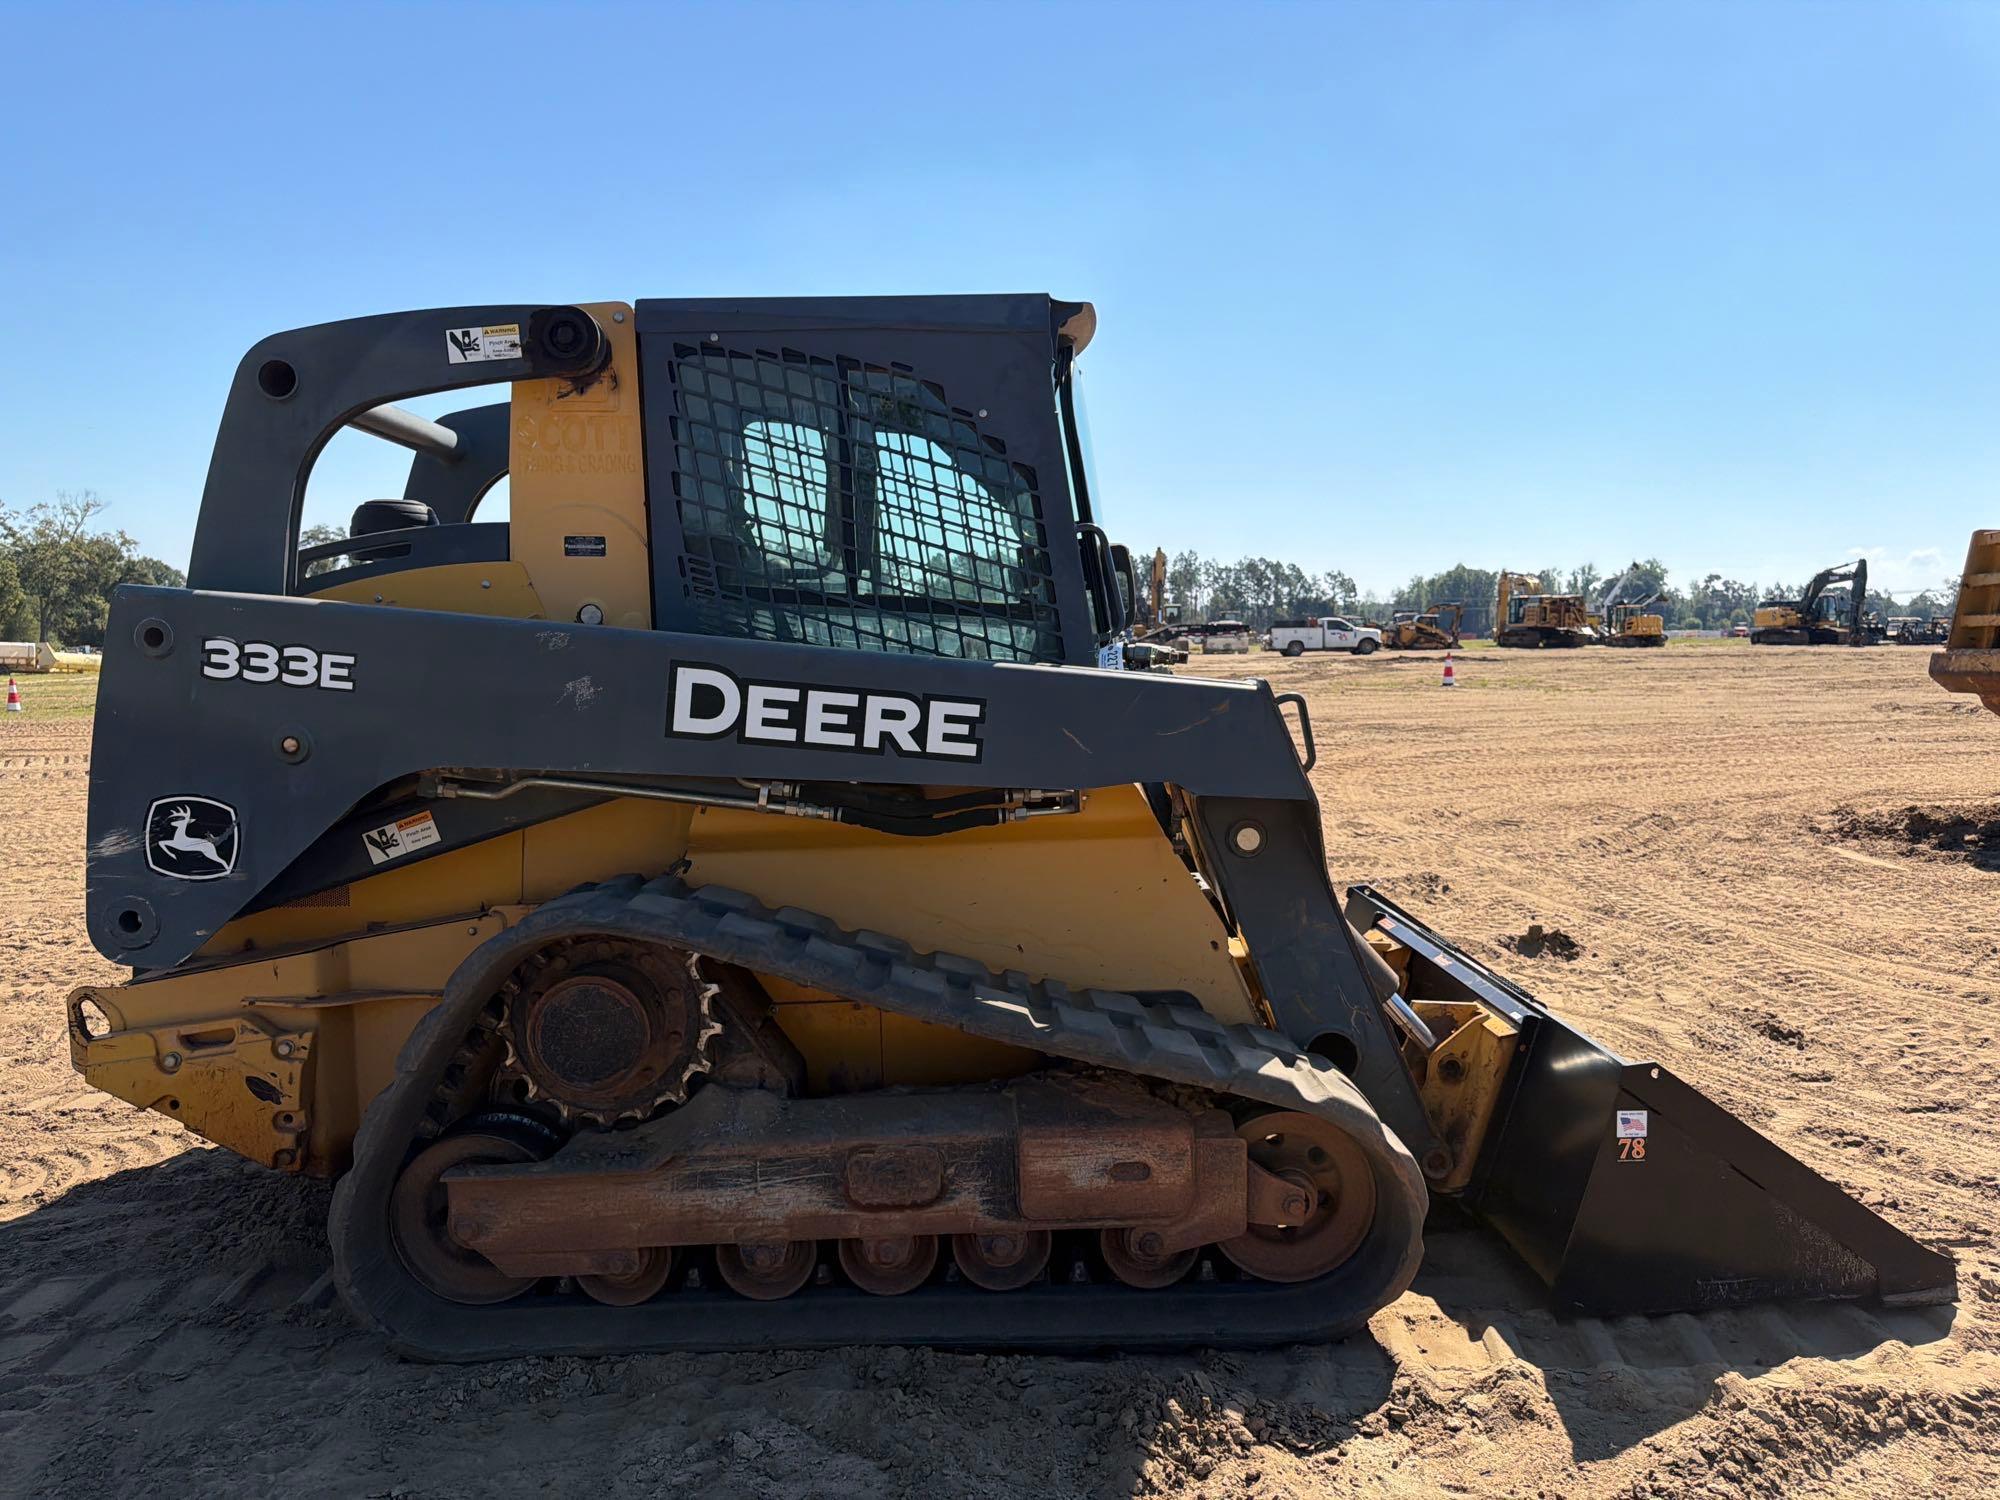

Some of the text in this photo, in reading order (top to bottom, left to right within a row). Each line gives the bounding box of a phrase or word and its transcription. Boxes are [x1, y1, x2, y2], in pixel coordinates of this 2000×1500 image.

[203, 638, 356, 690] 333E
[672, 666, 981, 757] DEERE
[403, 814, 429, 827] WARNING
[1618, 1138, 1645, 1159] 78
